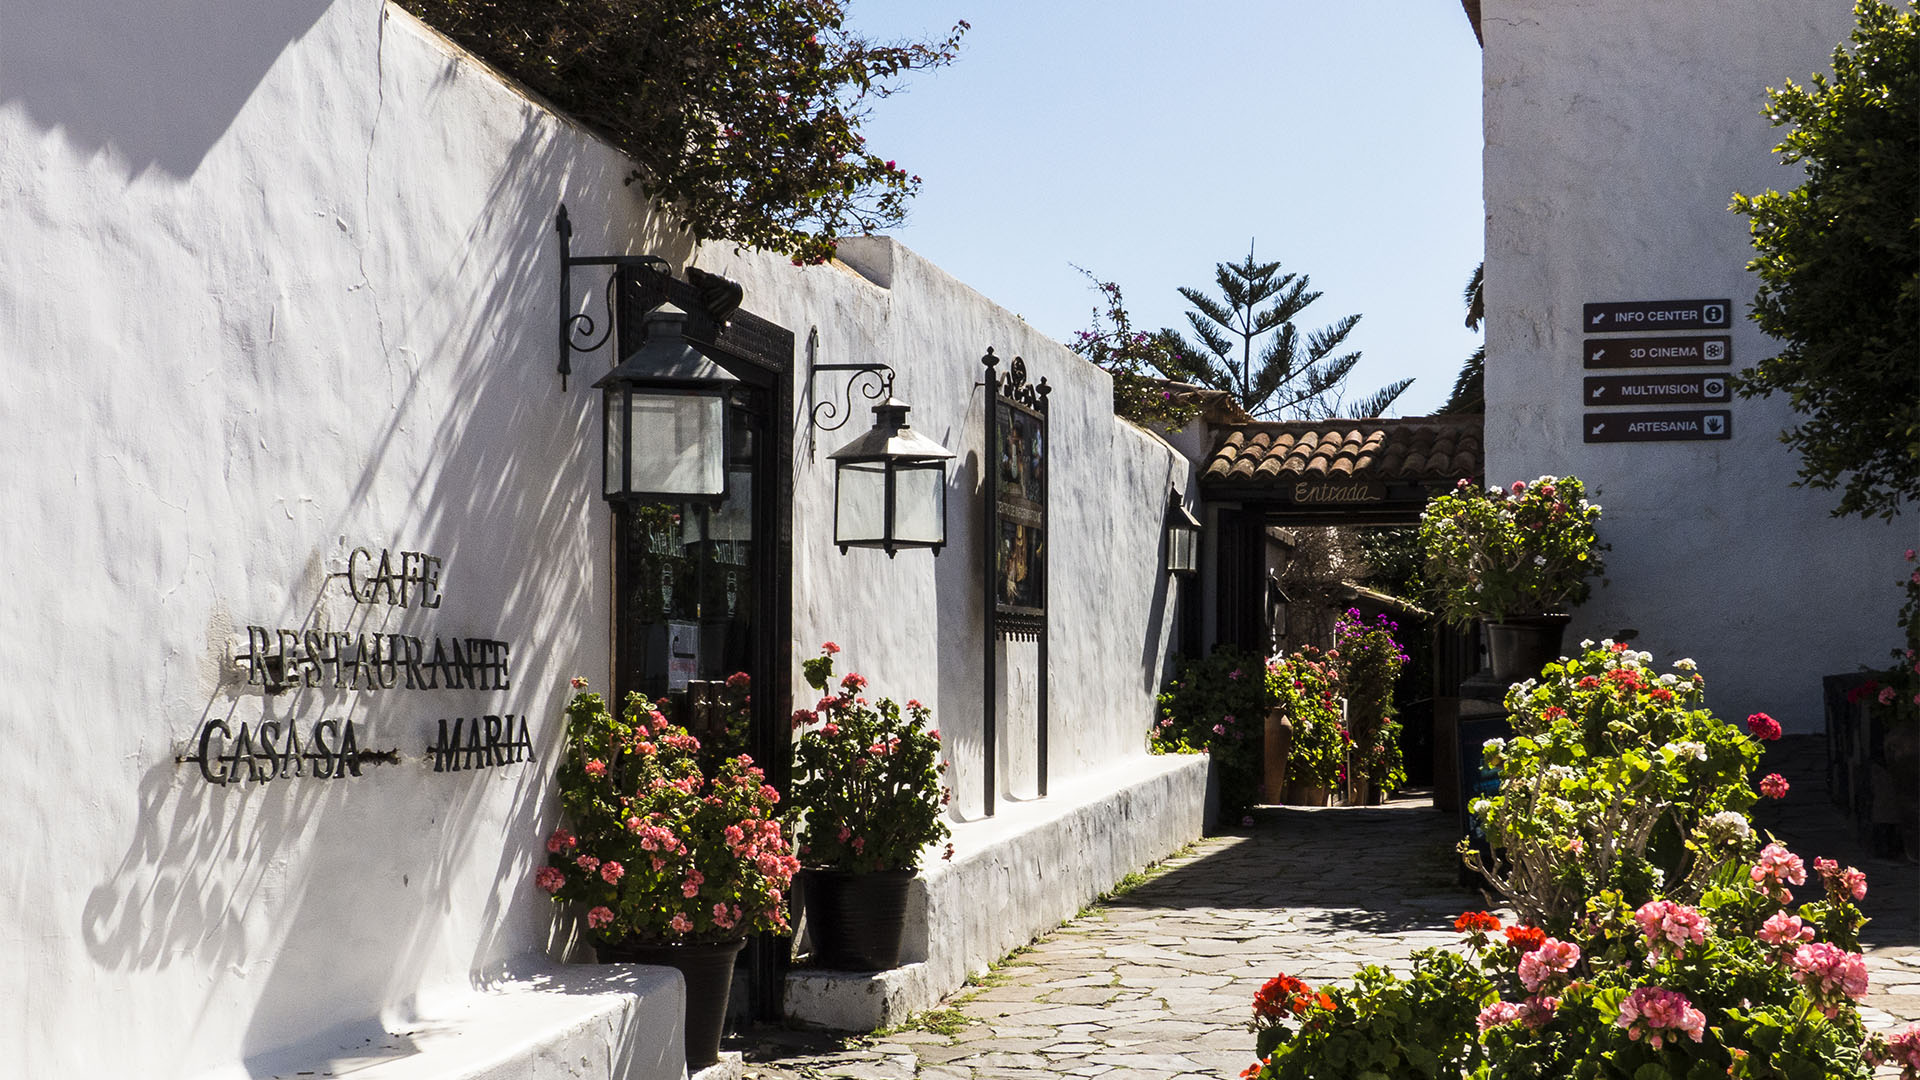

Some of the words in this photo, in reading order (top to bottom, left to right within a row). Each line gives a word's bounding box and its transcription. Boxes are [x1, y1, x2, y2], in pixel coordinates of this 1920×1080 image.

[1615, 311, 1644, 322] INFO
[1647, 310, 1698, 321] CENTER
[1630, 348, 1646, 358] 3D
[1649, 347, 1698, 357] CINEMA
[1622, 384, 1699, 395] MULTIVISION
[1628, 421, 1698, 432] ARTESANIA
[1296, 482, 1381, 502] Entrada
[349, 546, 442, 608] CAFE
[247, 625, 510, 691] RESTAURANTE
[434, 715, 536, 772] MARIA
